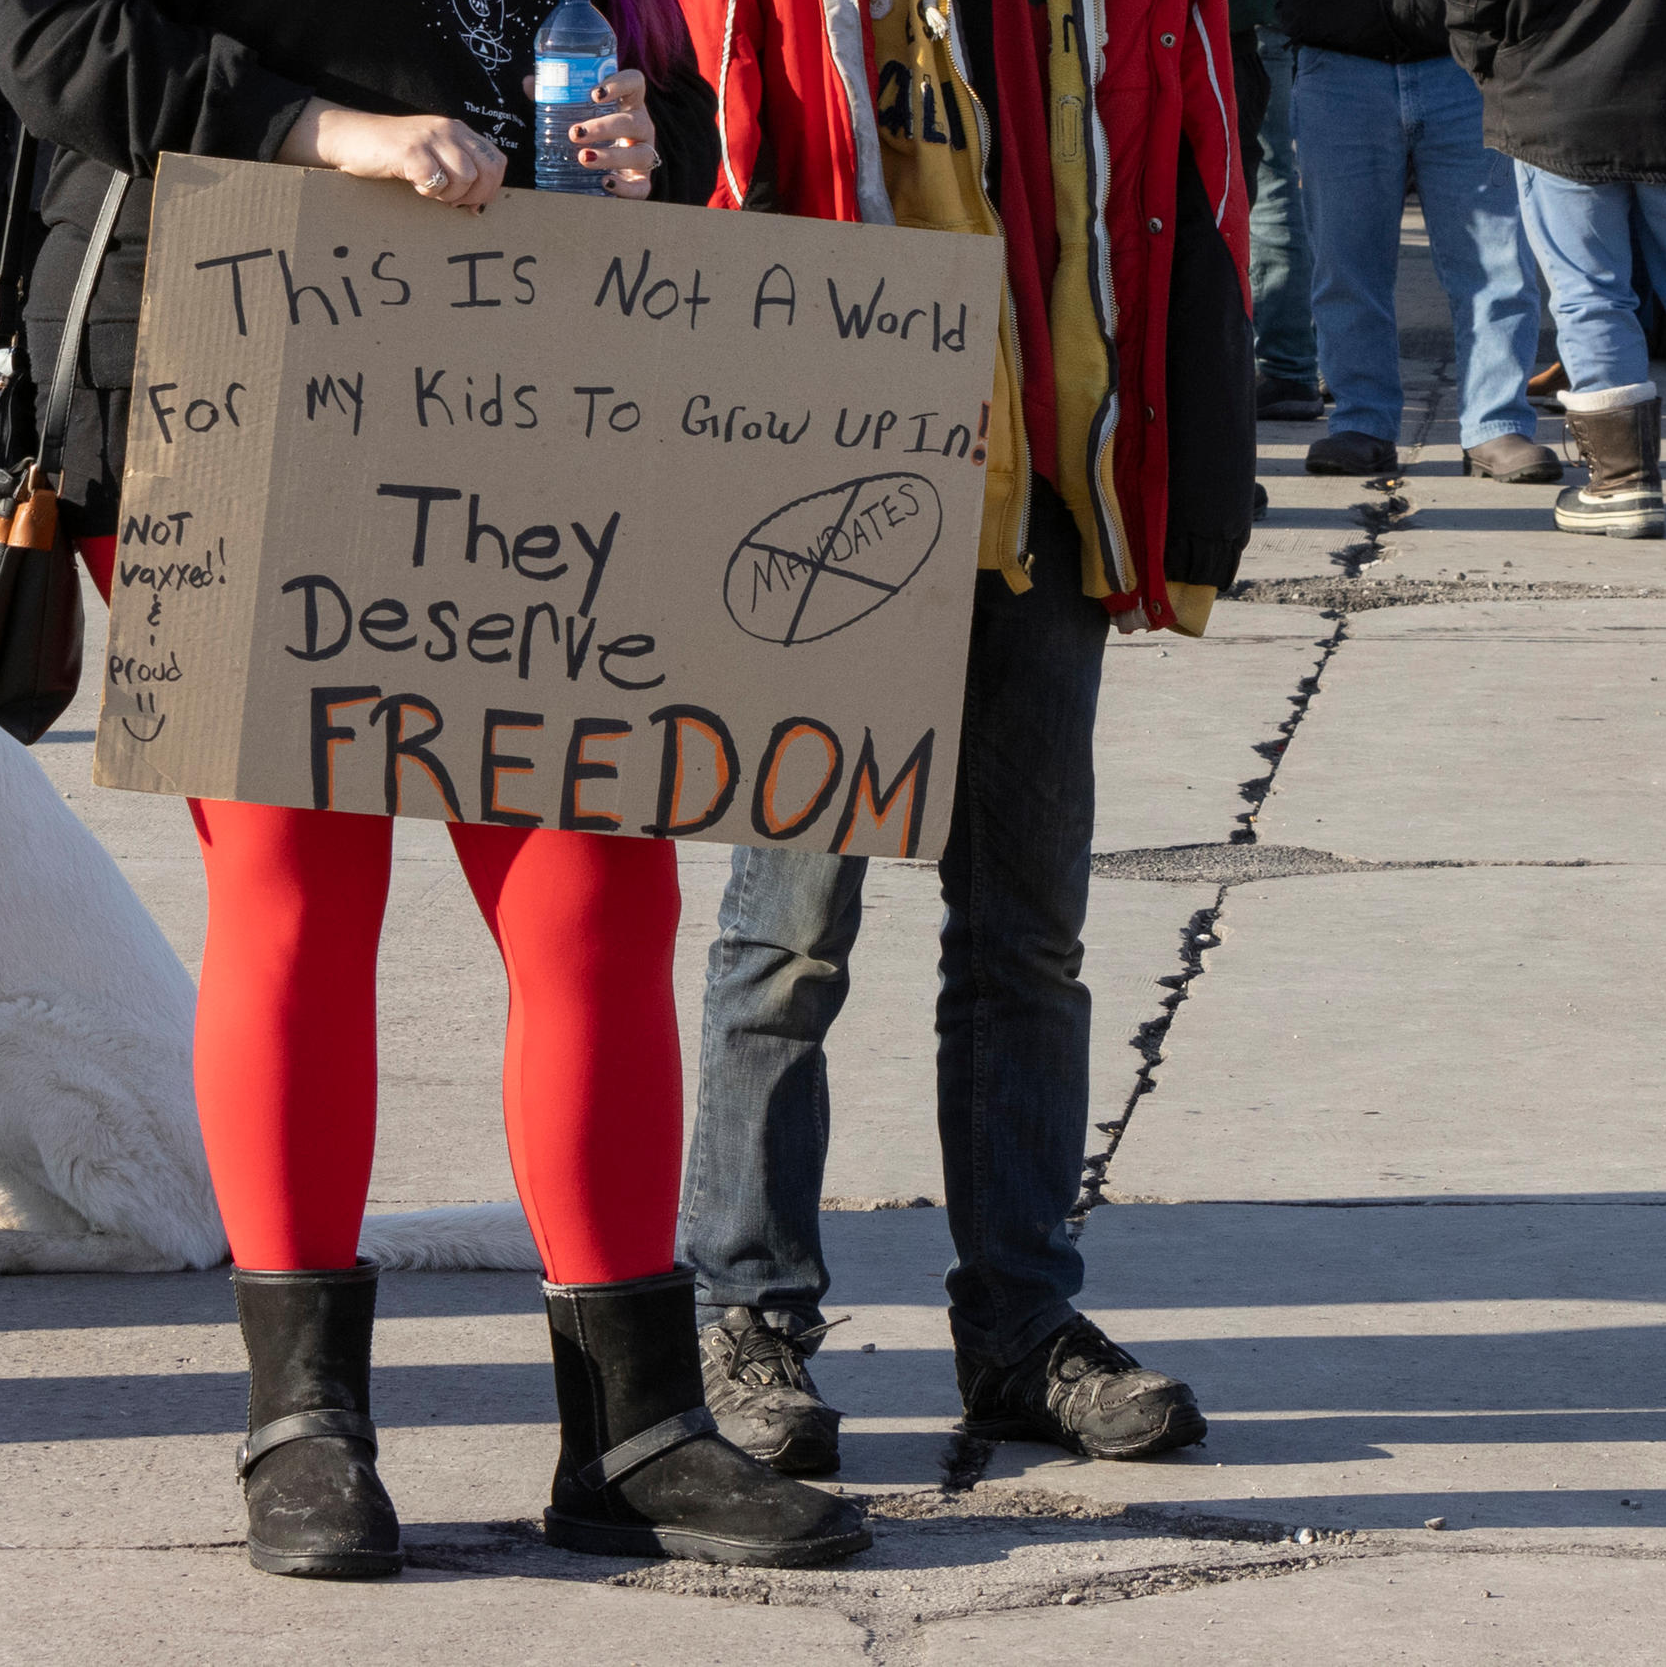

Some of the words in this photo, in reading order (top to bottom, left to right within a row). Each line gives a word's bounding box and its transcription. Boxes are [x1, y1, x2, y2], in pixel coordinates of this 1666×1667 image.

[464, 101, 480, 114] The
[492, 122, 506, 134] of
[499, 137, 519, 149] Year
[595, 249, 711, 331] Not
[753, 263, 796, 329] A
[827, 276, 967, 353] World
[148, 382, 247, 445] For
[415, 366, 538, 429] Kids
[681, 394, 810, 445] Grow
[122, 511, 193, 546] NOT
[377, 483, 621, 614] They
[751, 483, 919, 614] MANDATES
[281, 573, 665, 691] Deserve
[308, 684, 936, 861] FREEDOM
